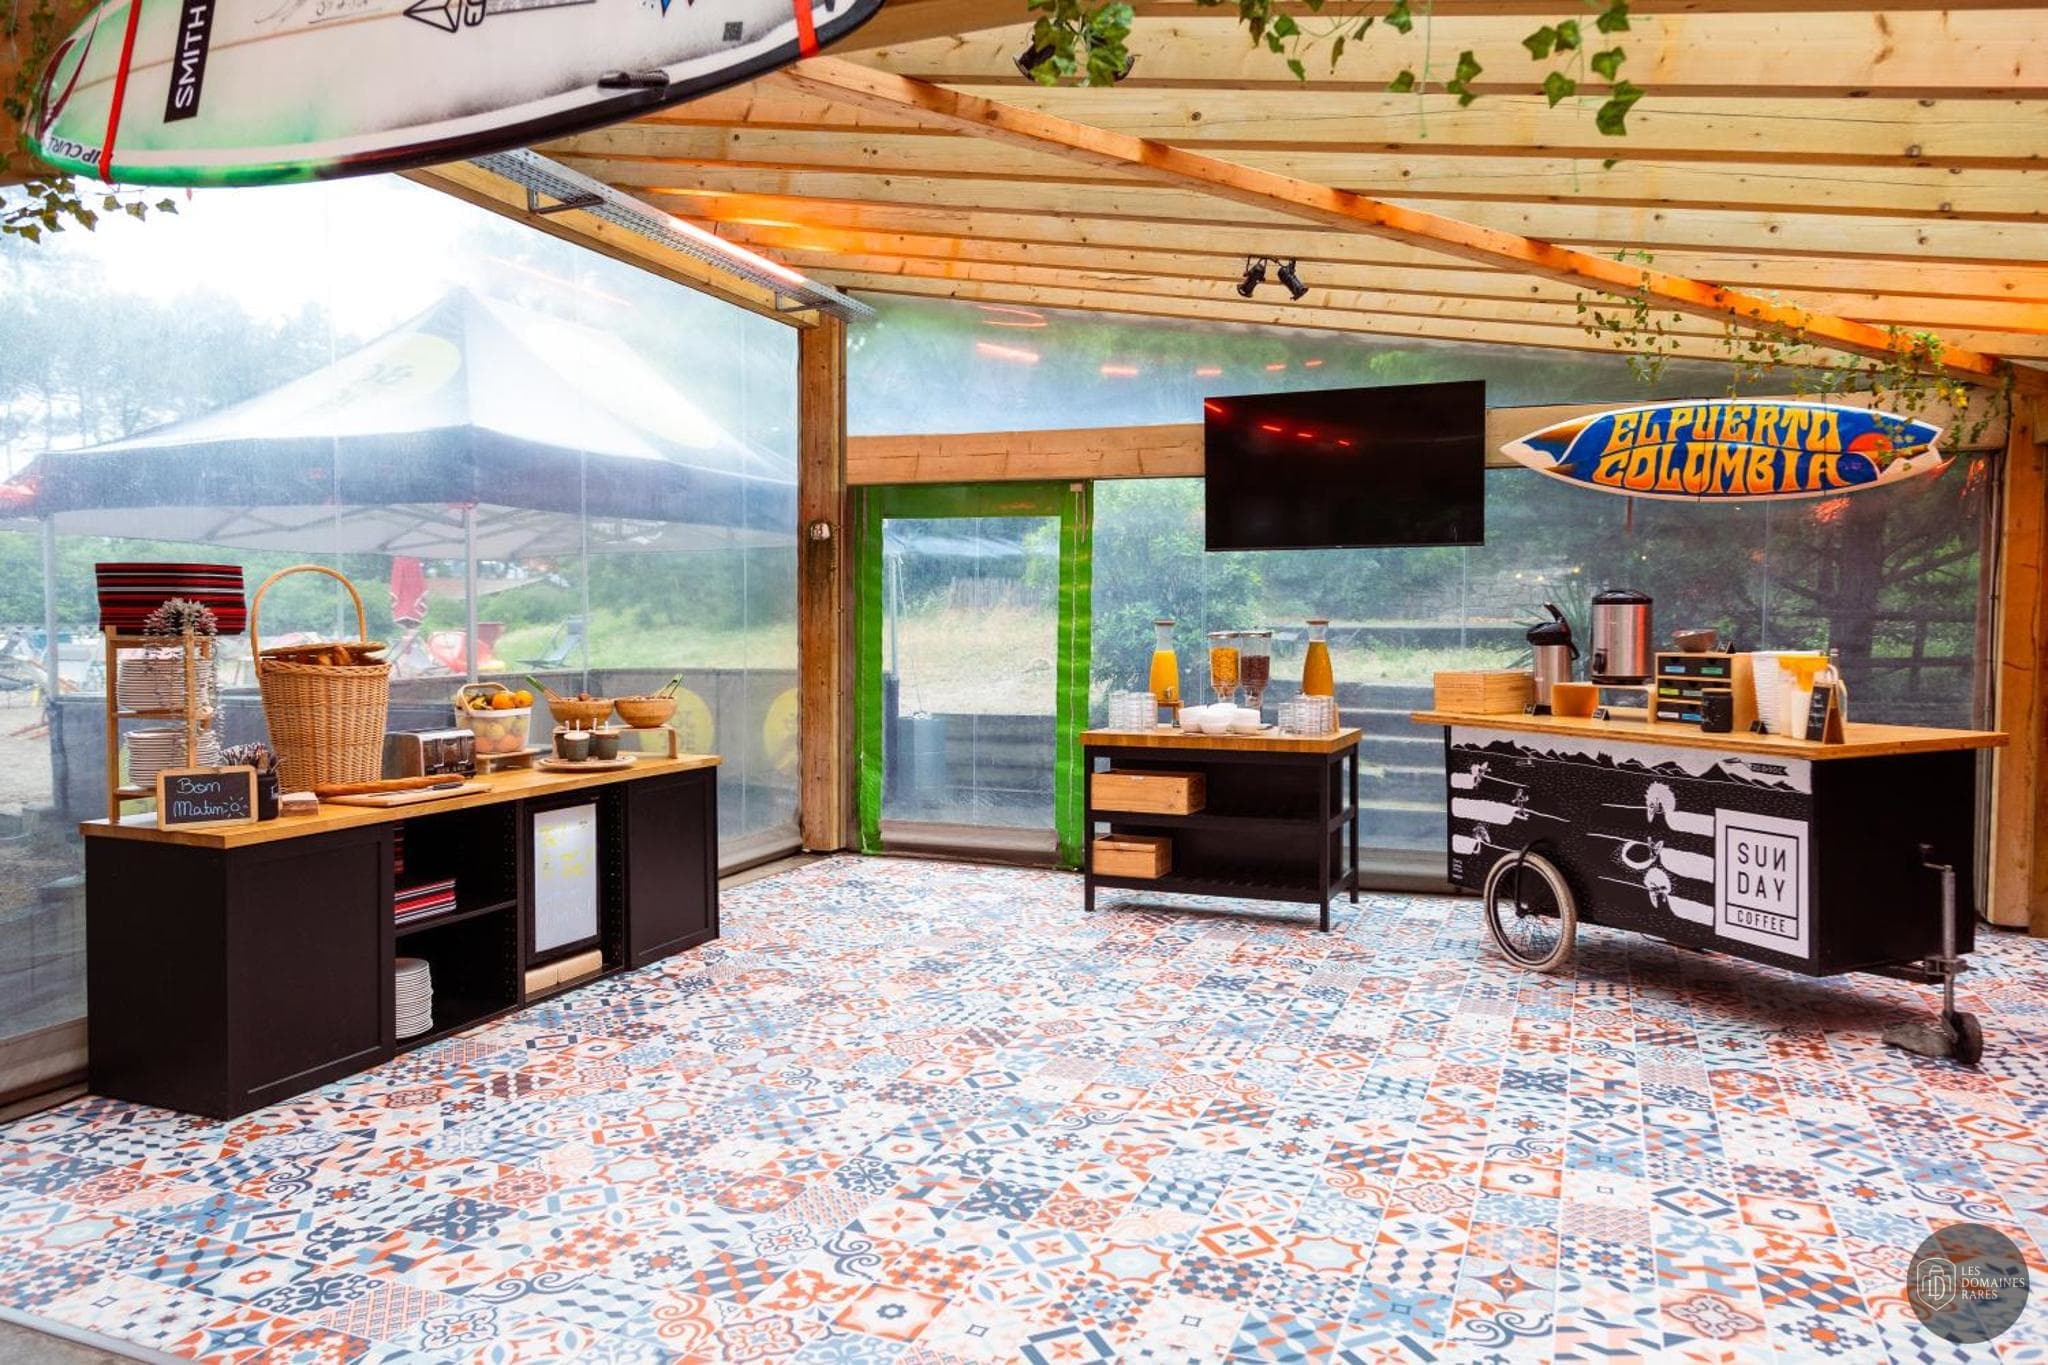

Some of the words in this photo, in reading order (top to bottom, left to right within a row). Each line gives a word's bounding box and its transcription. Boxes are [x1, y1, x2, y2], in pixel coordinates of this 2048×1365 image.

[175, 5, 207, 108] SMITH
[1602, 411, 1661, 455] EL
[1666, 405, 1842, 452] PUERTO
[1592, 442, 1854, 494] COLOMBIA
[176, 777, 221, 794] Bon
[173, 800, 224, 818] Matin
[1737, 842, 1786, 872] SUN
[1737, 871, 1785, 902] DAY
[1737, 910, 1786, 933] COFFEE
